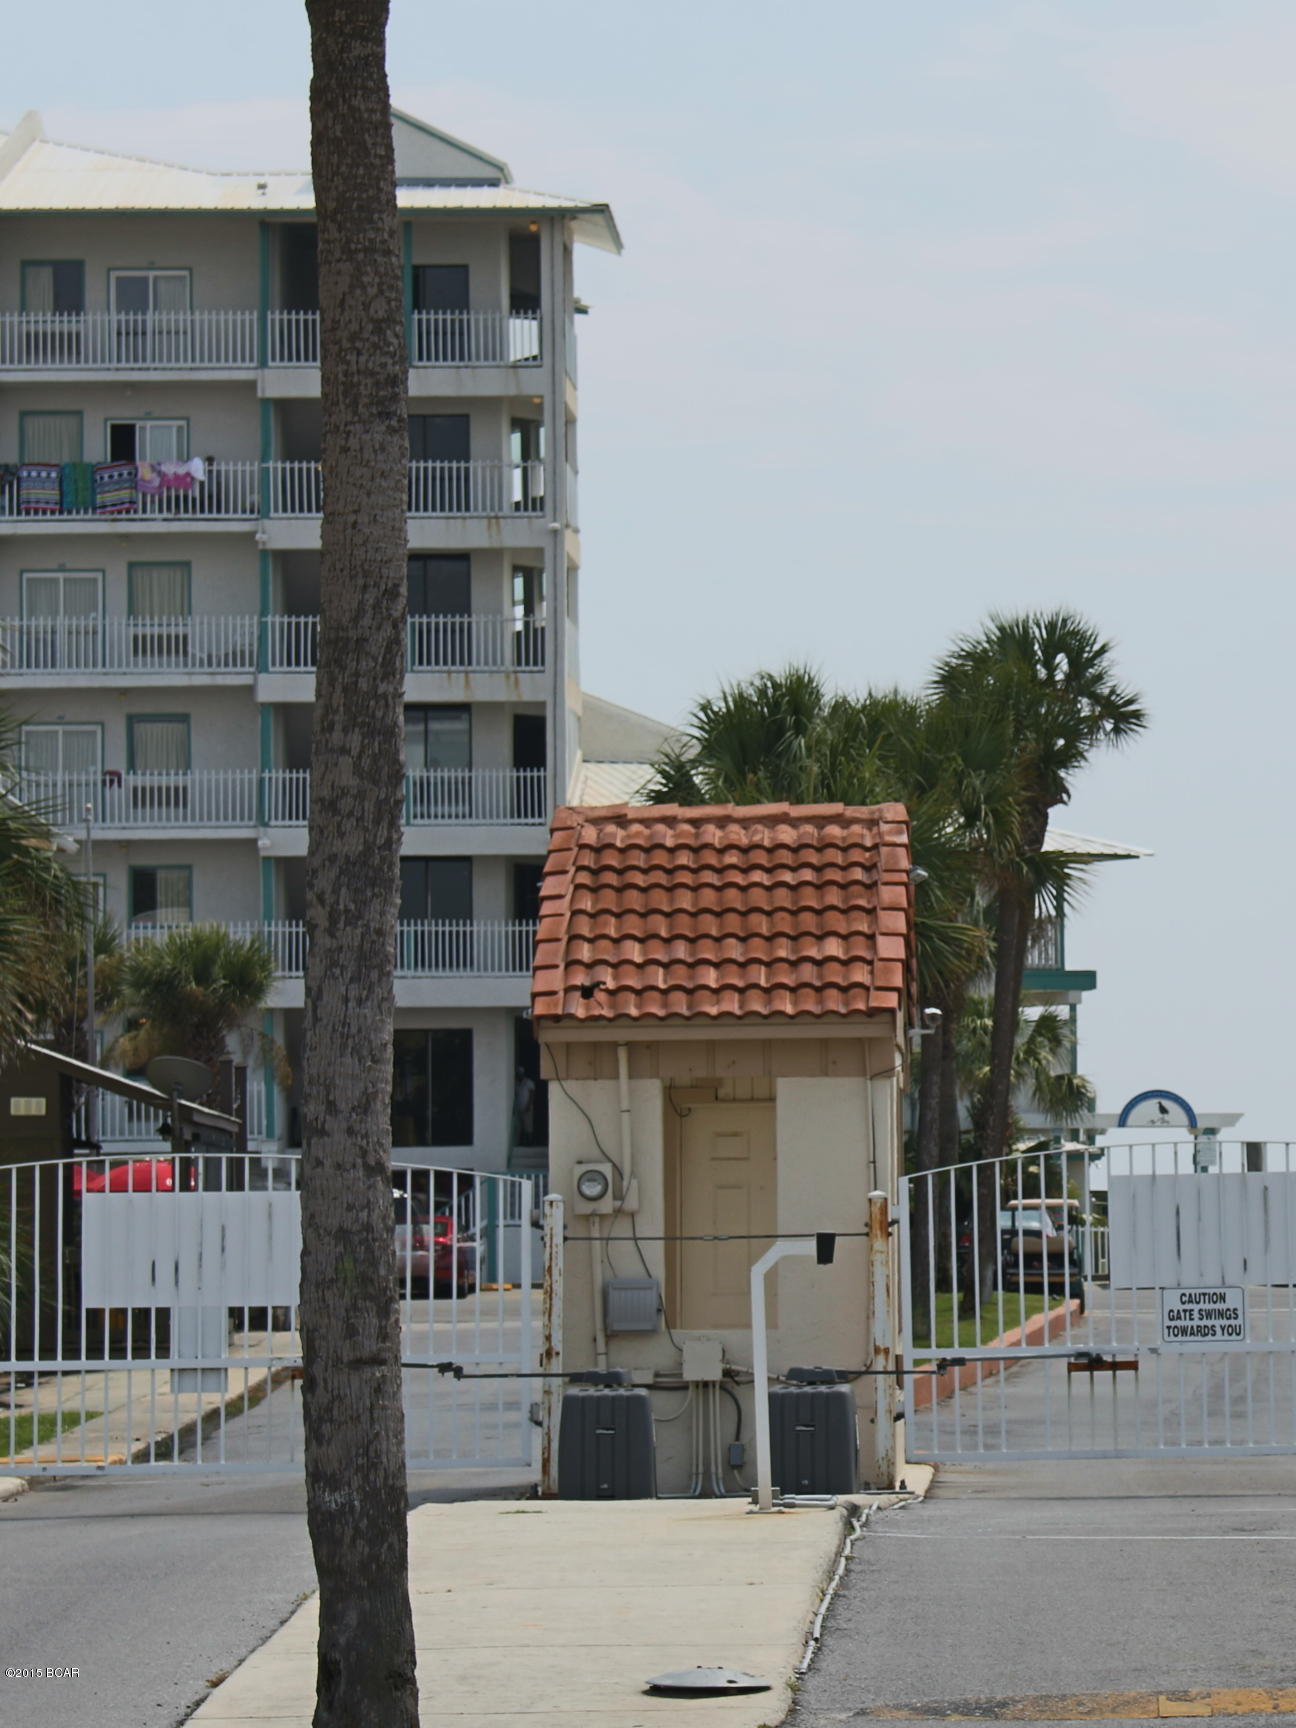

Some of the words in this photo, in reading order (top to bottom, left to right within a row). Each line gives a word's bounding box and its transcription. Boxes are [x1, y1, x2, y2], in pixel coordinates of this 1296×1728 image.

[1179, 1291, 1226, 1305] CAUTION
[1167, 1308, 1195, 1321] GATE
[1198, 1307, 1239, 1321] SWINGS
[1166, 1324, 1217, 1338] TOWARDS
[1220, 1323, 1242, 1337] YOU
